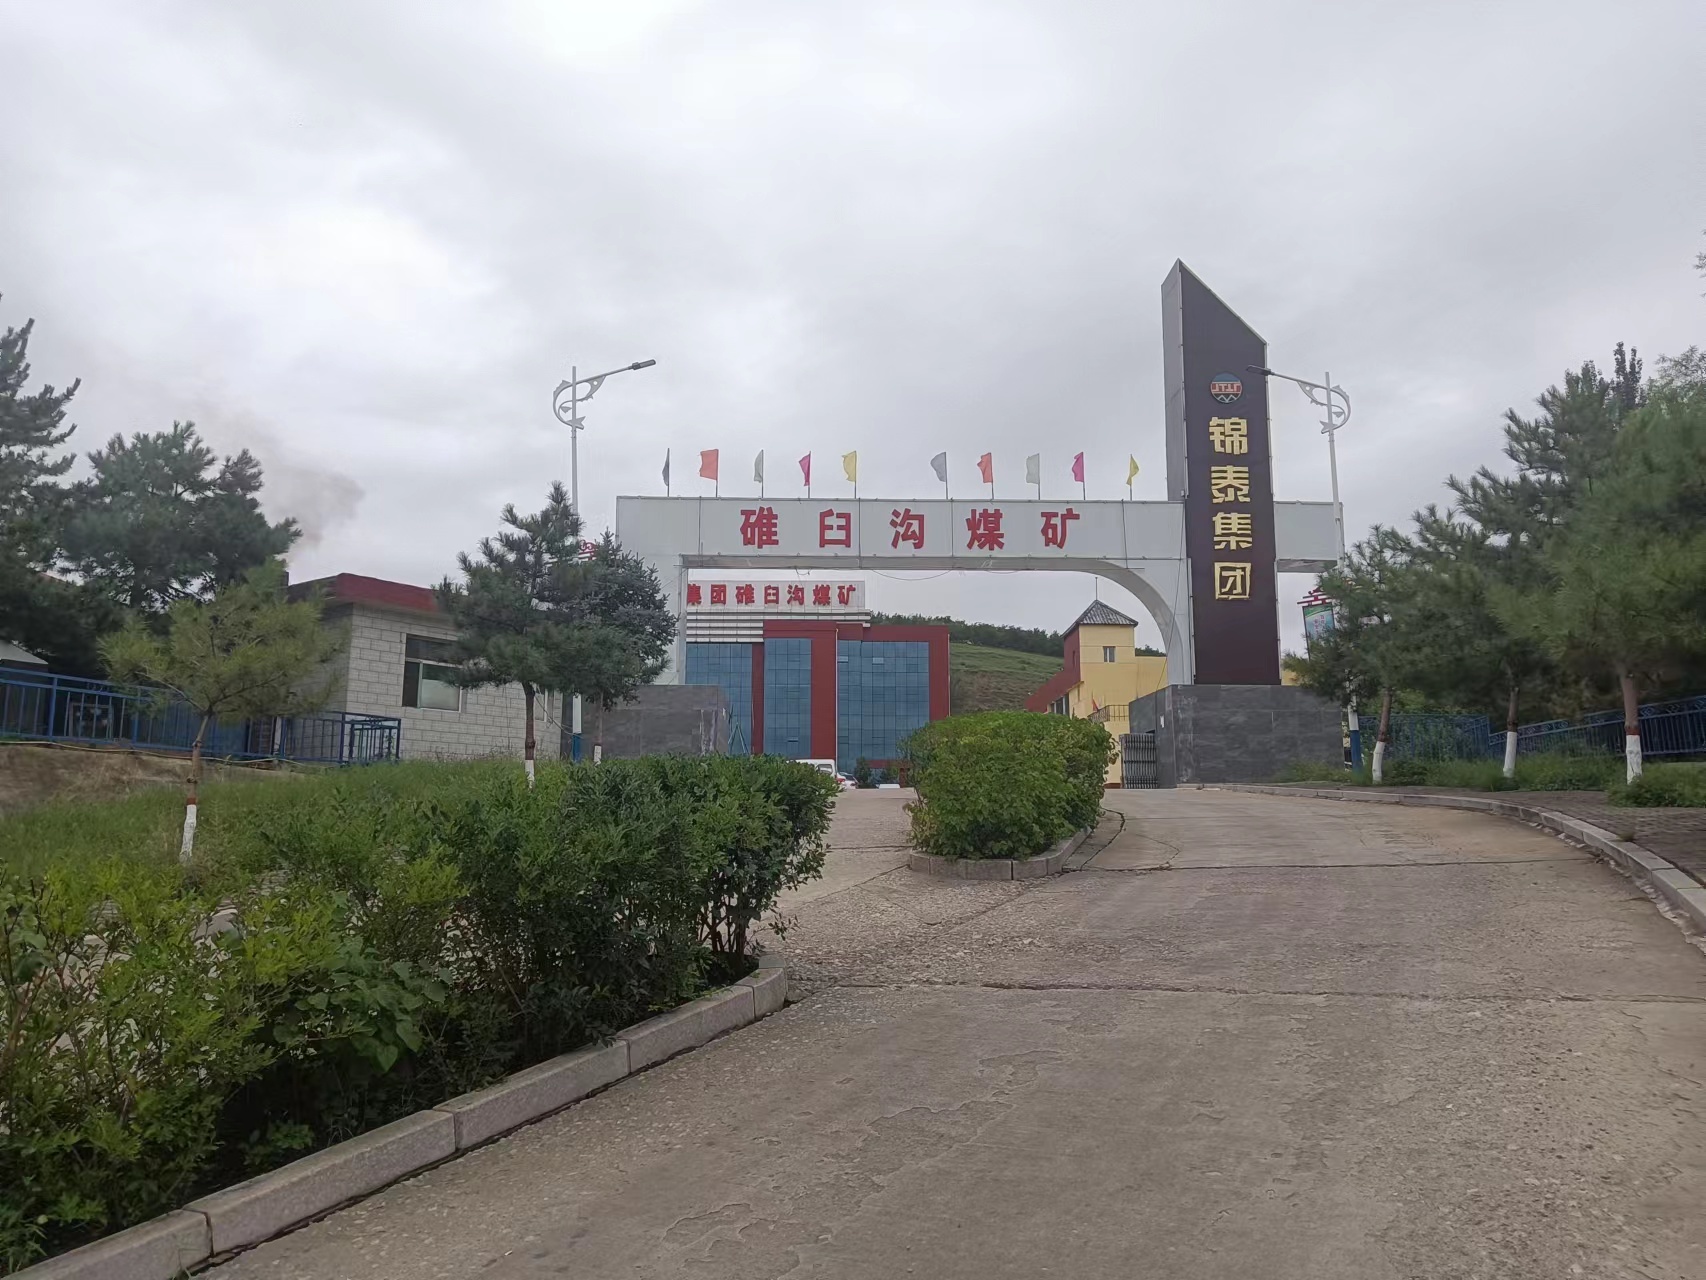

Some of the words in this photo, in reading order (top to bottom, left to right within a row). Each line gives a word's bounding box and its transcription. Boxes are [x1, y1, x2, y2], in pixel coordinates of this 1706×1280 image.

[740, 506, 1080, 550] 碓臼沟煤矿
[1209, 417, 1253, 600] 锦泰集团
